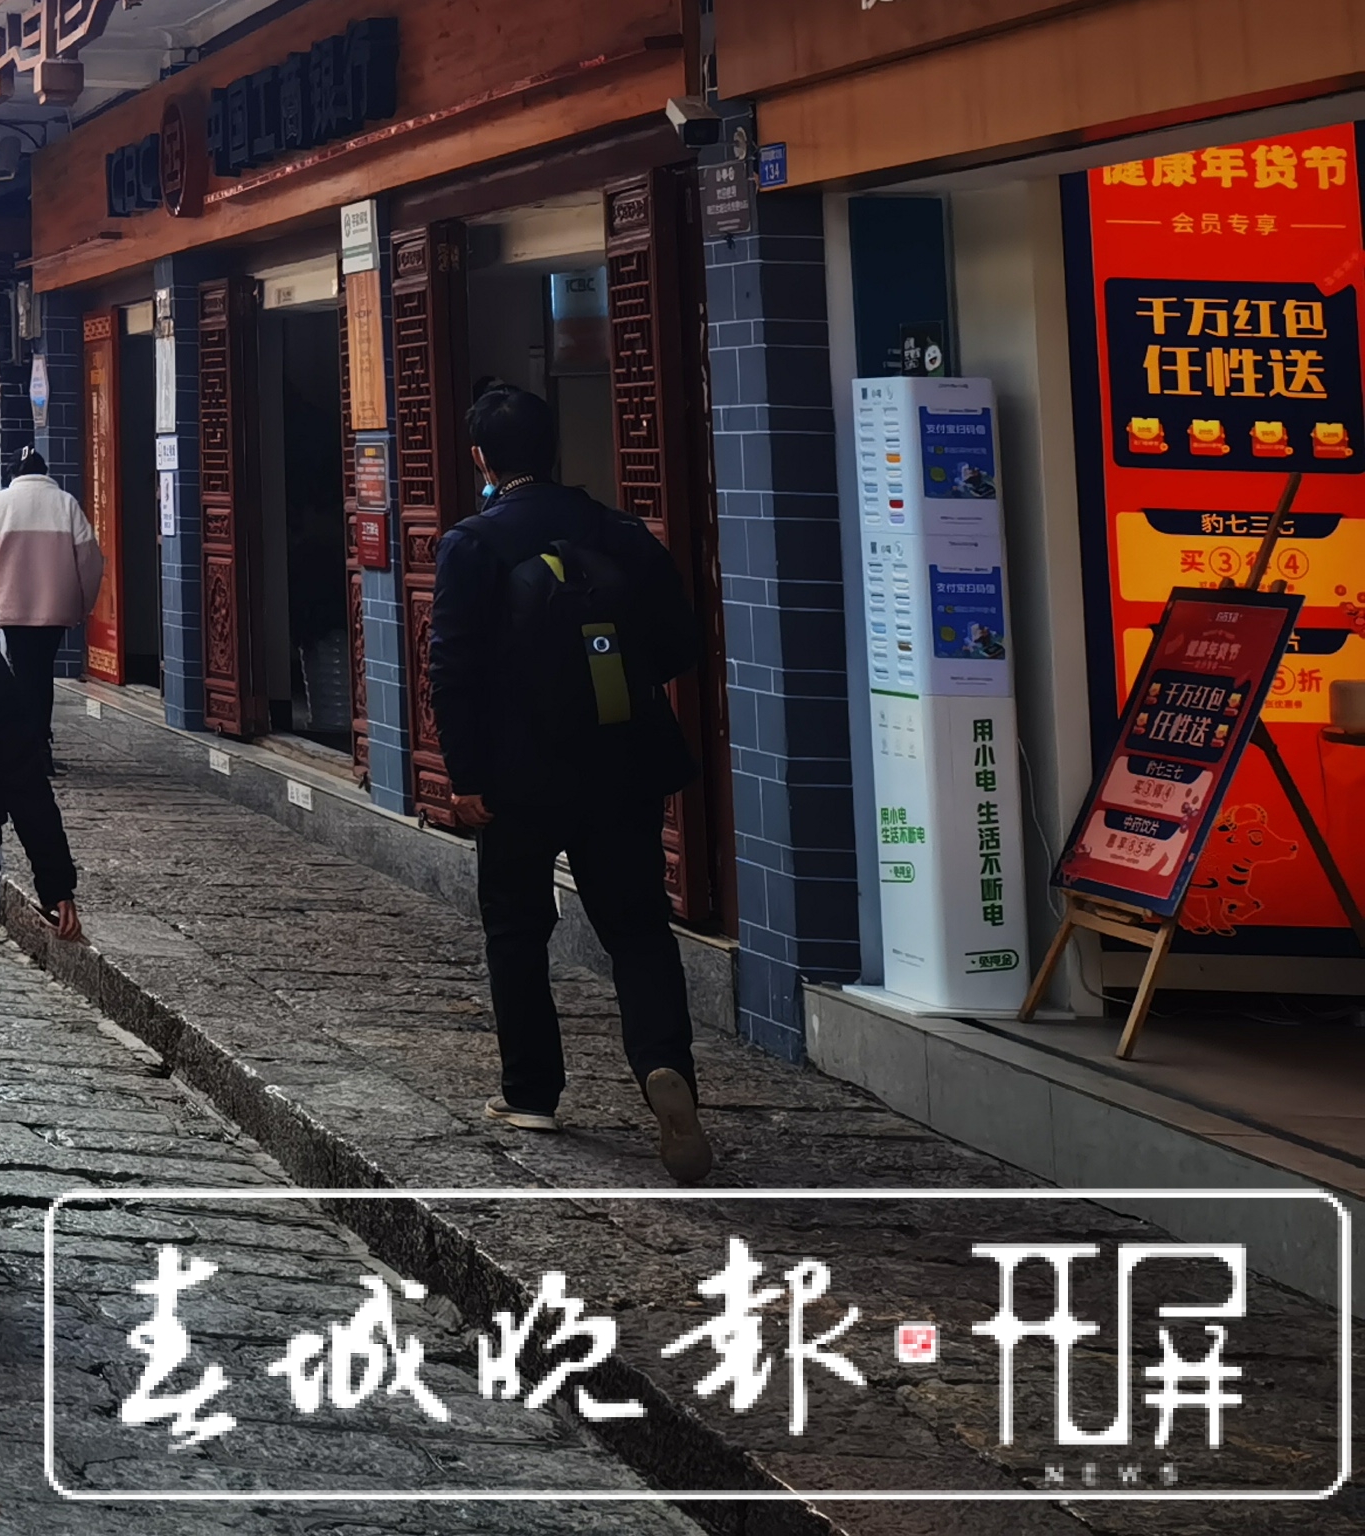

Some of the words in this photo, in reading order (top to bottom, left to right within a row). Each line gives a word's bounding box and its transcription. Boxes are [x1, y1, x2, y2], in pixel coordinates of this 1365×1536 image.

[206, 17, 400, 178] 中国工商银行
[765, 162, 780, 181] 134
[1103, 145, 1347, 190] 健康年货节
[1172, 212, 1278, 235] 会员专享
[565, 278, 596, 293] ICBC
[1136, 297, 1328, 339] 千万红包
[1142, 345, 1328, 399] 任性送
[1165, 682, 1227, 713] 千万红包
[1149, 710, 1213, 748] 任性送
[973, 719, 997, 792] 用小电
[881, 807, 907, 825] 用小电
[881, 826, 926, 844] 生活不断电
[977, 801, 1005, 927] 生活不断电
[978, 953, 1013, 968] 免押金
